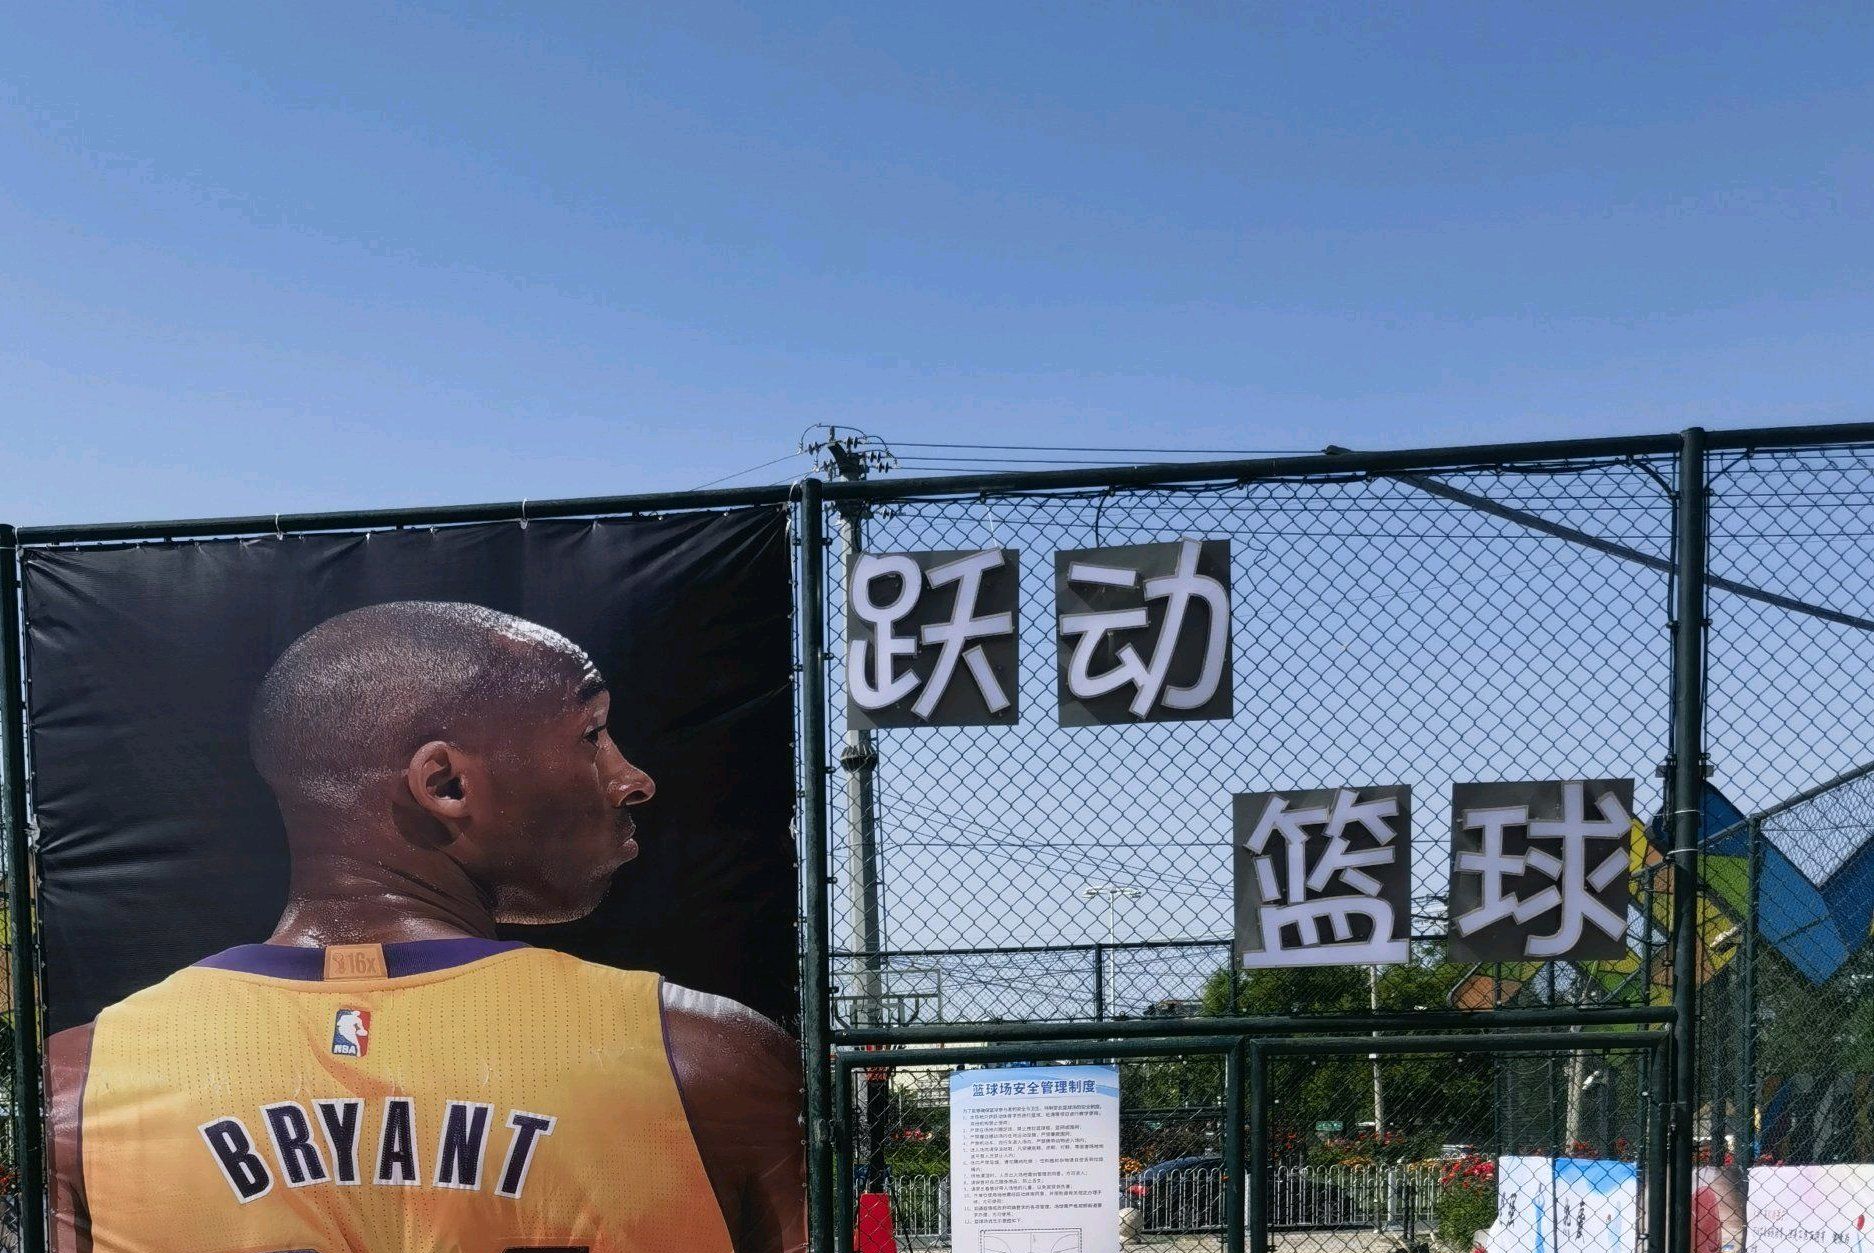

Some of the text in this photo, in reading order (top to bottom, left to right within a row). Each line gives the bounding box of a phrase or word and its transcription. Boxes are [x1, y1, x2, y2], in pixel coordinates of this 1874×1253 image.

[849, 537, 1231, 720] 跃动
[1243, 780, 1632, 968] 篮球
[333, 1044, 357, 1055] NBA
[972, 1079, 1096, 1097] 篮球场安全管理制度
[197, 1096, 558, 1205] BRYANT
